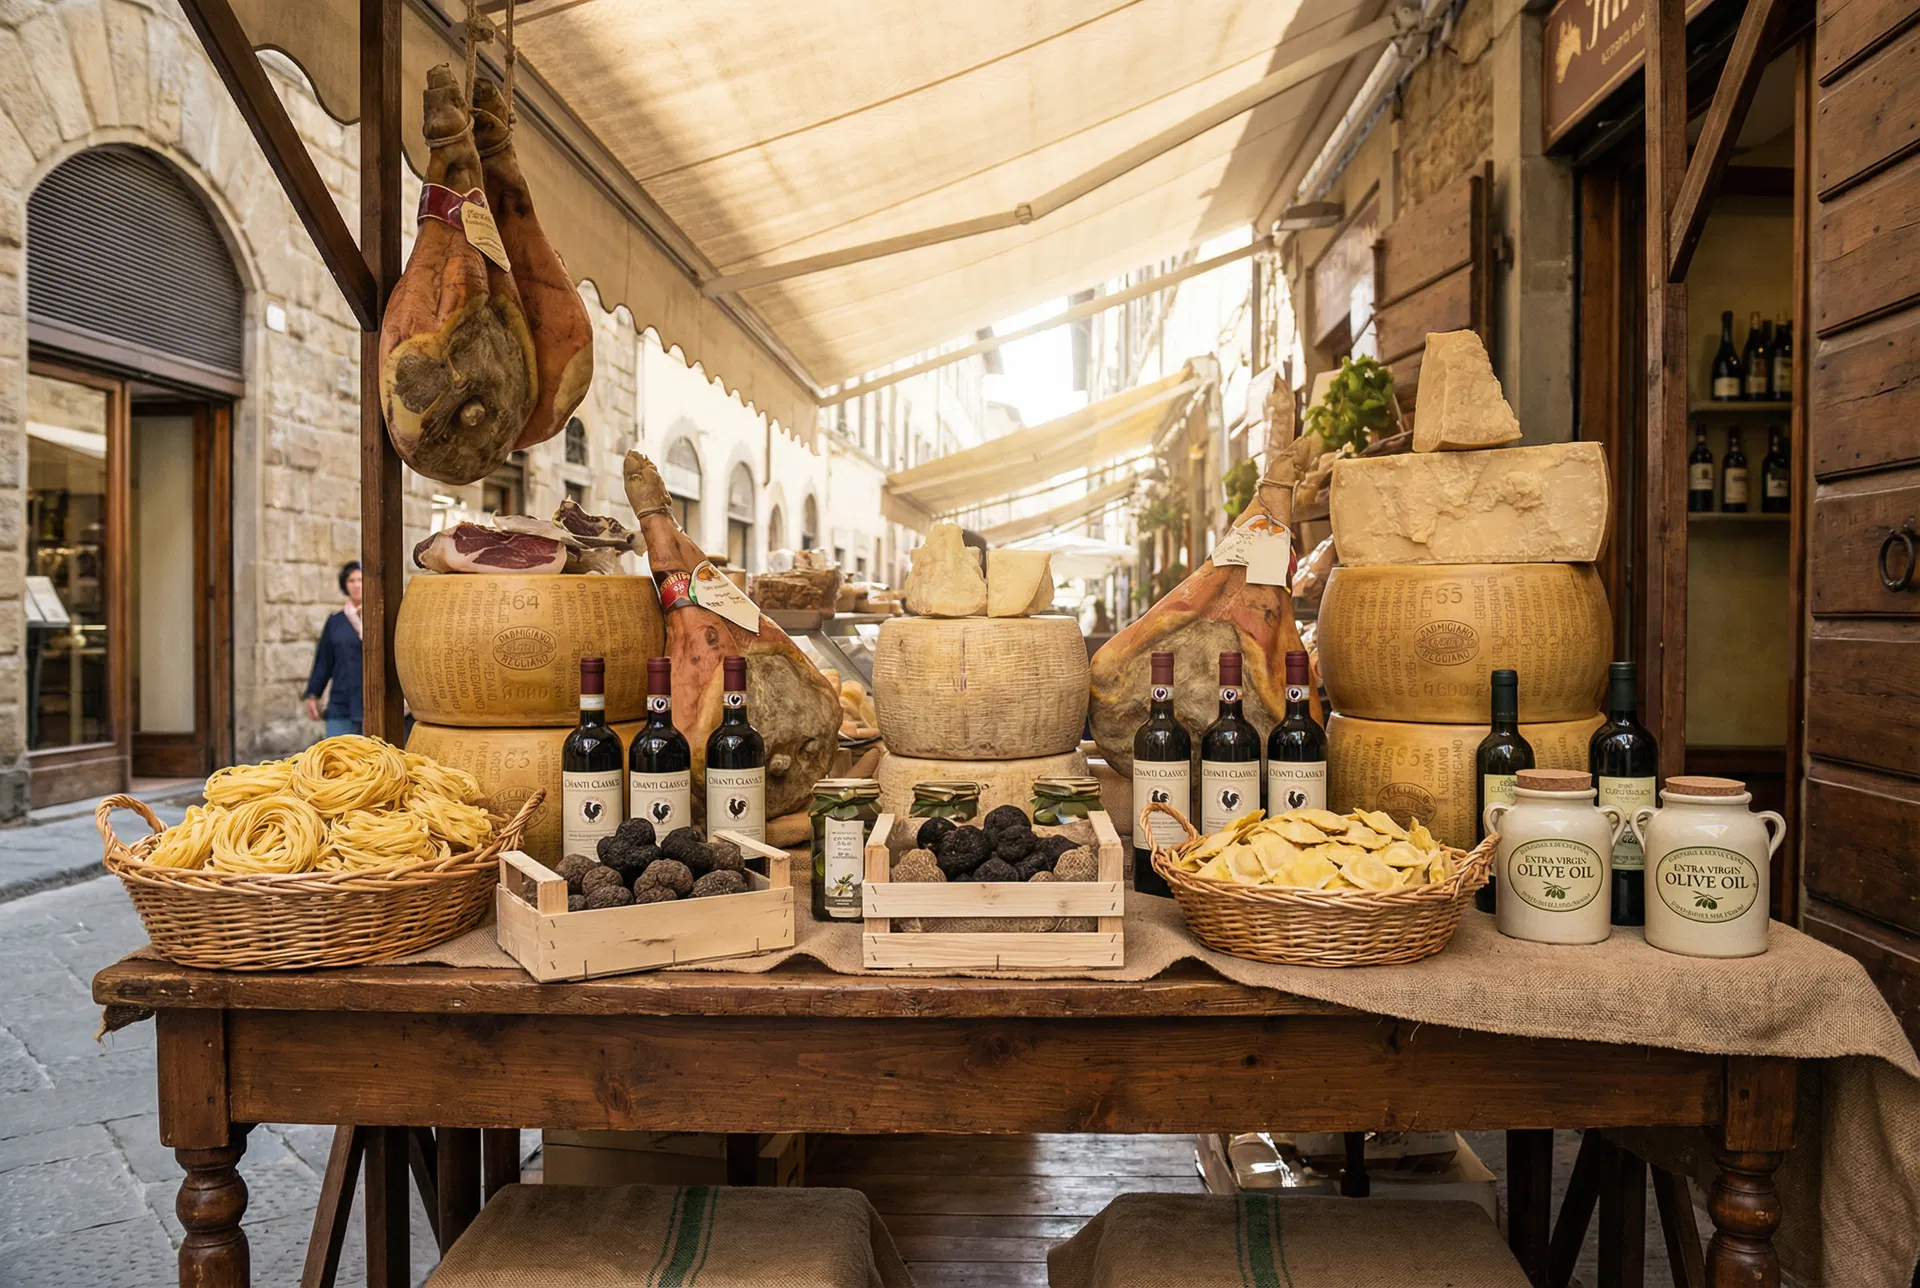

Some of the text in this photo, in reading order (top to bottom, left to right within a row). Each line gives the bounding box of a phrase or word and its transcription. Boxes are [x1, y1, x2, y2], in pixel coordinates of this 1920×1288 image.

[1525, 855, 1587, 866] EXTRA VIRGIN
[1517, 863, 1595, 879] OLIVE OIL
[1674, 863, 1741, 876] EXTRA VIRGIN
[1665, 872, 1750, 890] OLIVE OIL
